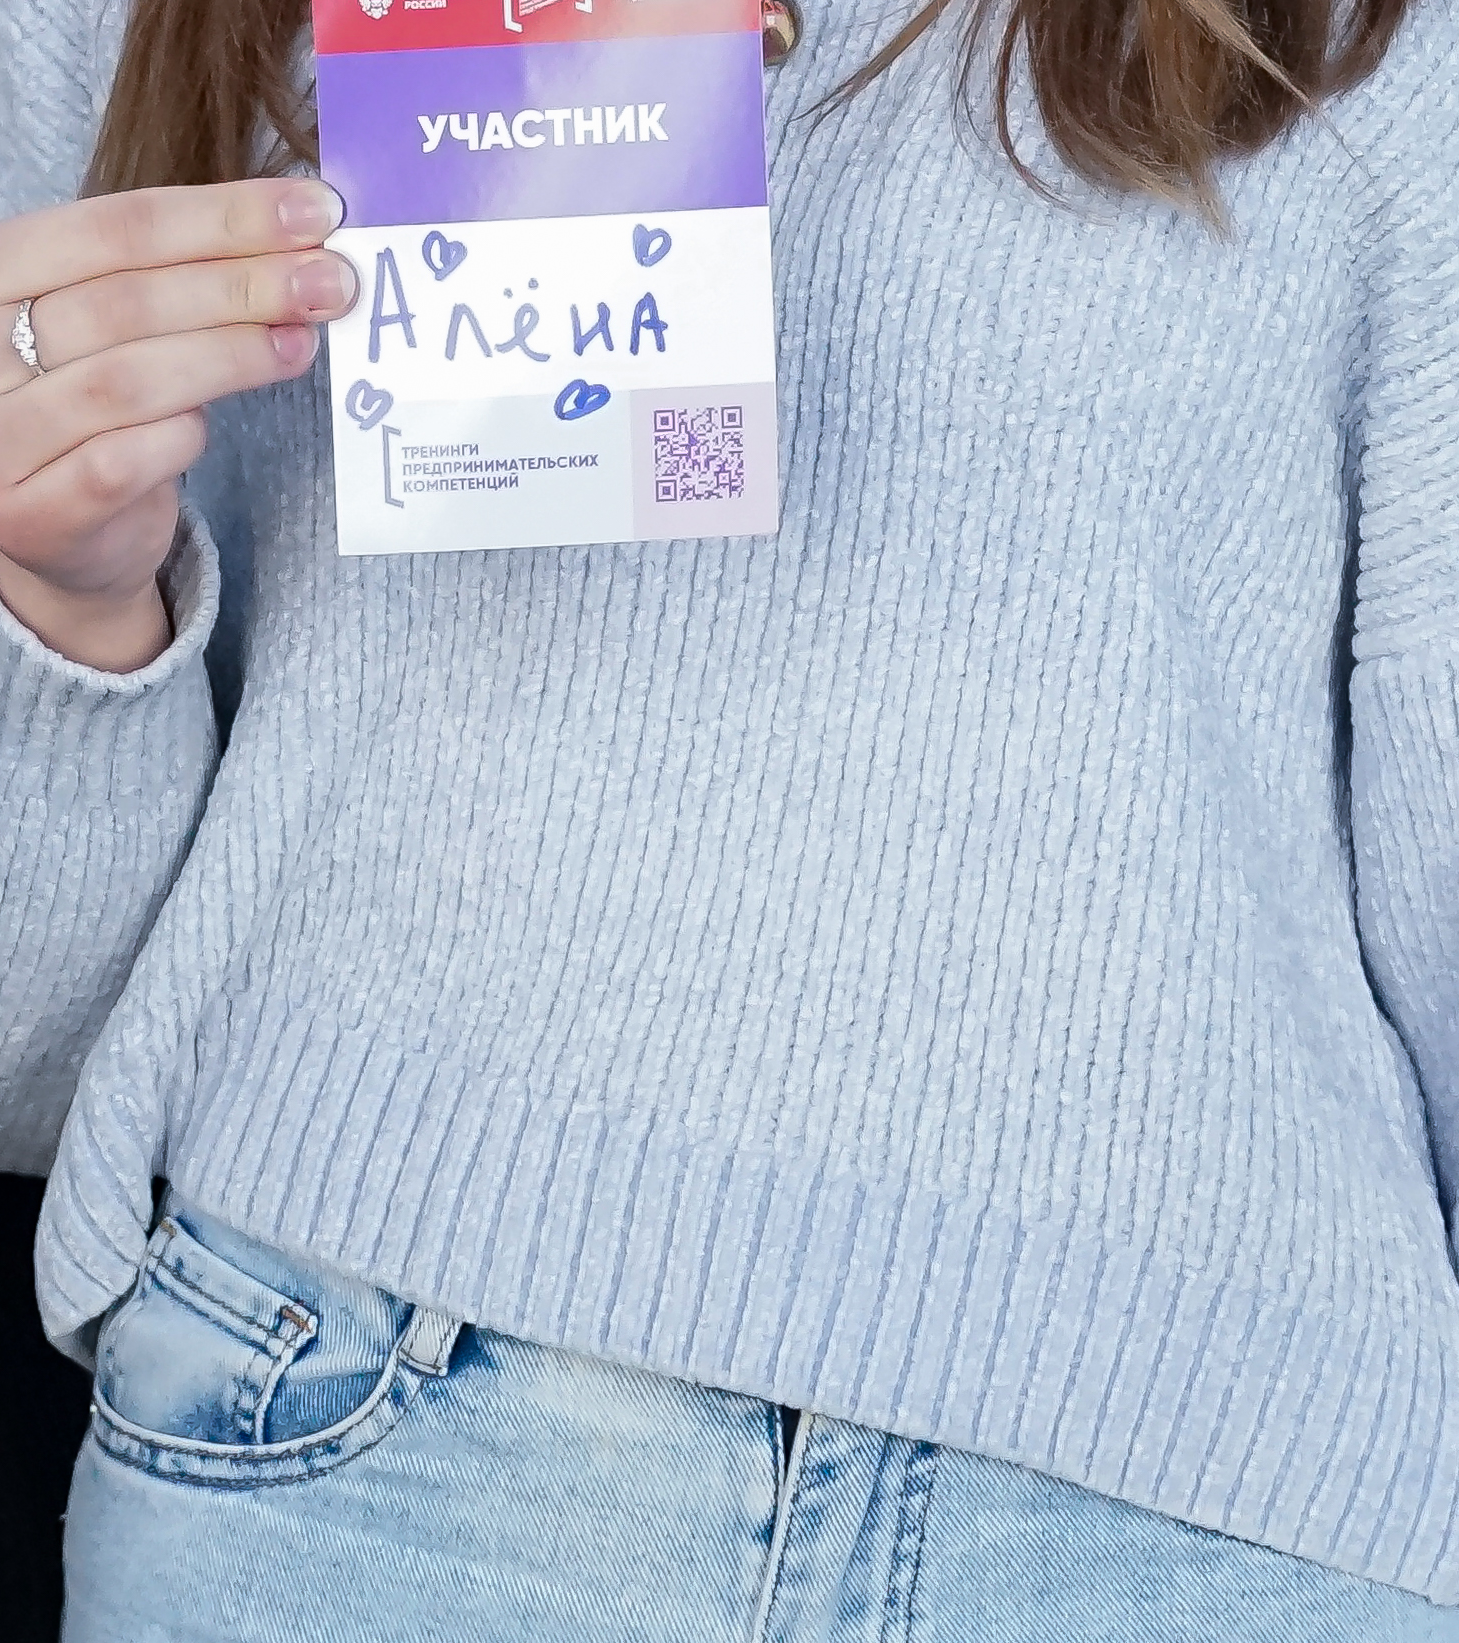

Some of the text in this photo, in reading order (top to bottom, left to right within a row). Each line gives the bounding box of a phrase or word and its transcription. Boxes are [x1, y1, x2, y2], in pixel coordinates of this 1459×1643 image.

[404, 0, 447, 10] РОССИИ
[417, 102, 669, 154] УЧАСТНИК
[401, 443, 479, 459] ТРЕНИНГИ
[402, 454, 599, 477] ПРЕДПРИНИМАТЕЛЬСКИХ
[403, 472, 519, 493] КОМПЕТЕНЦИЙ
